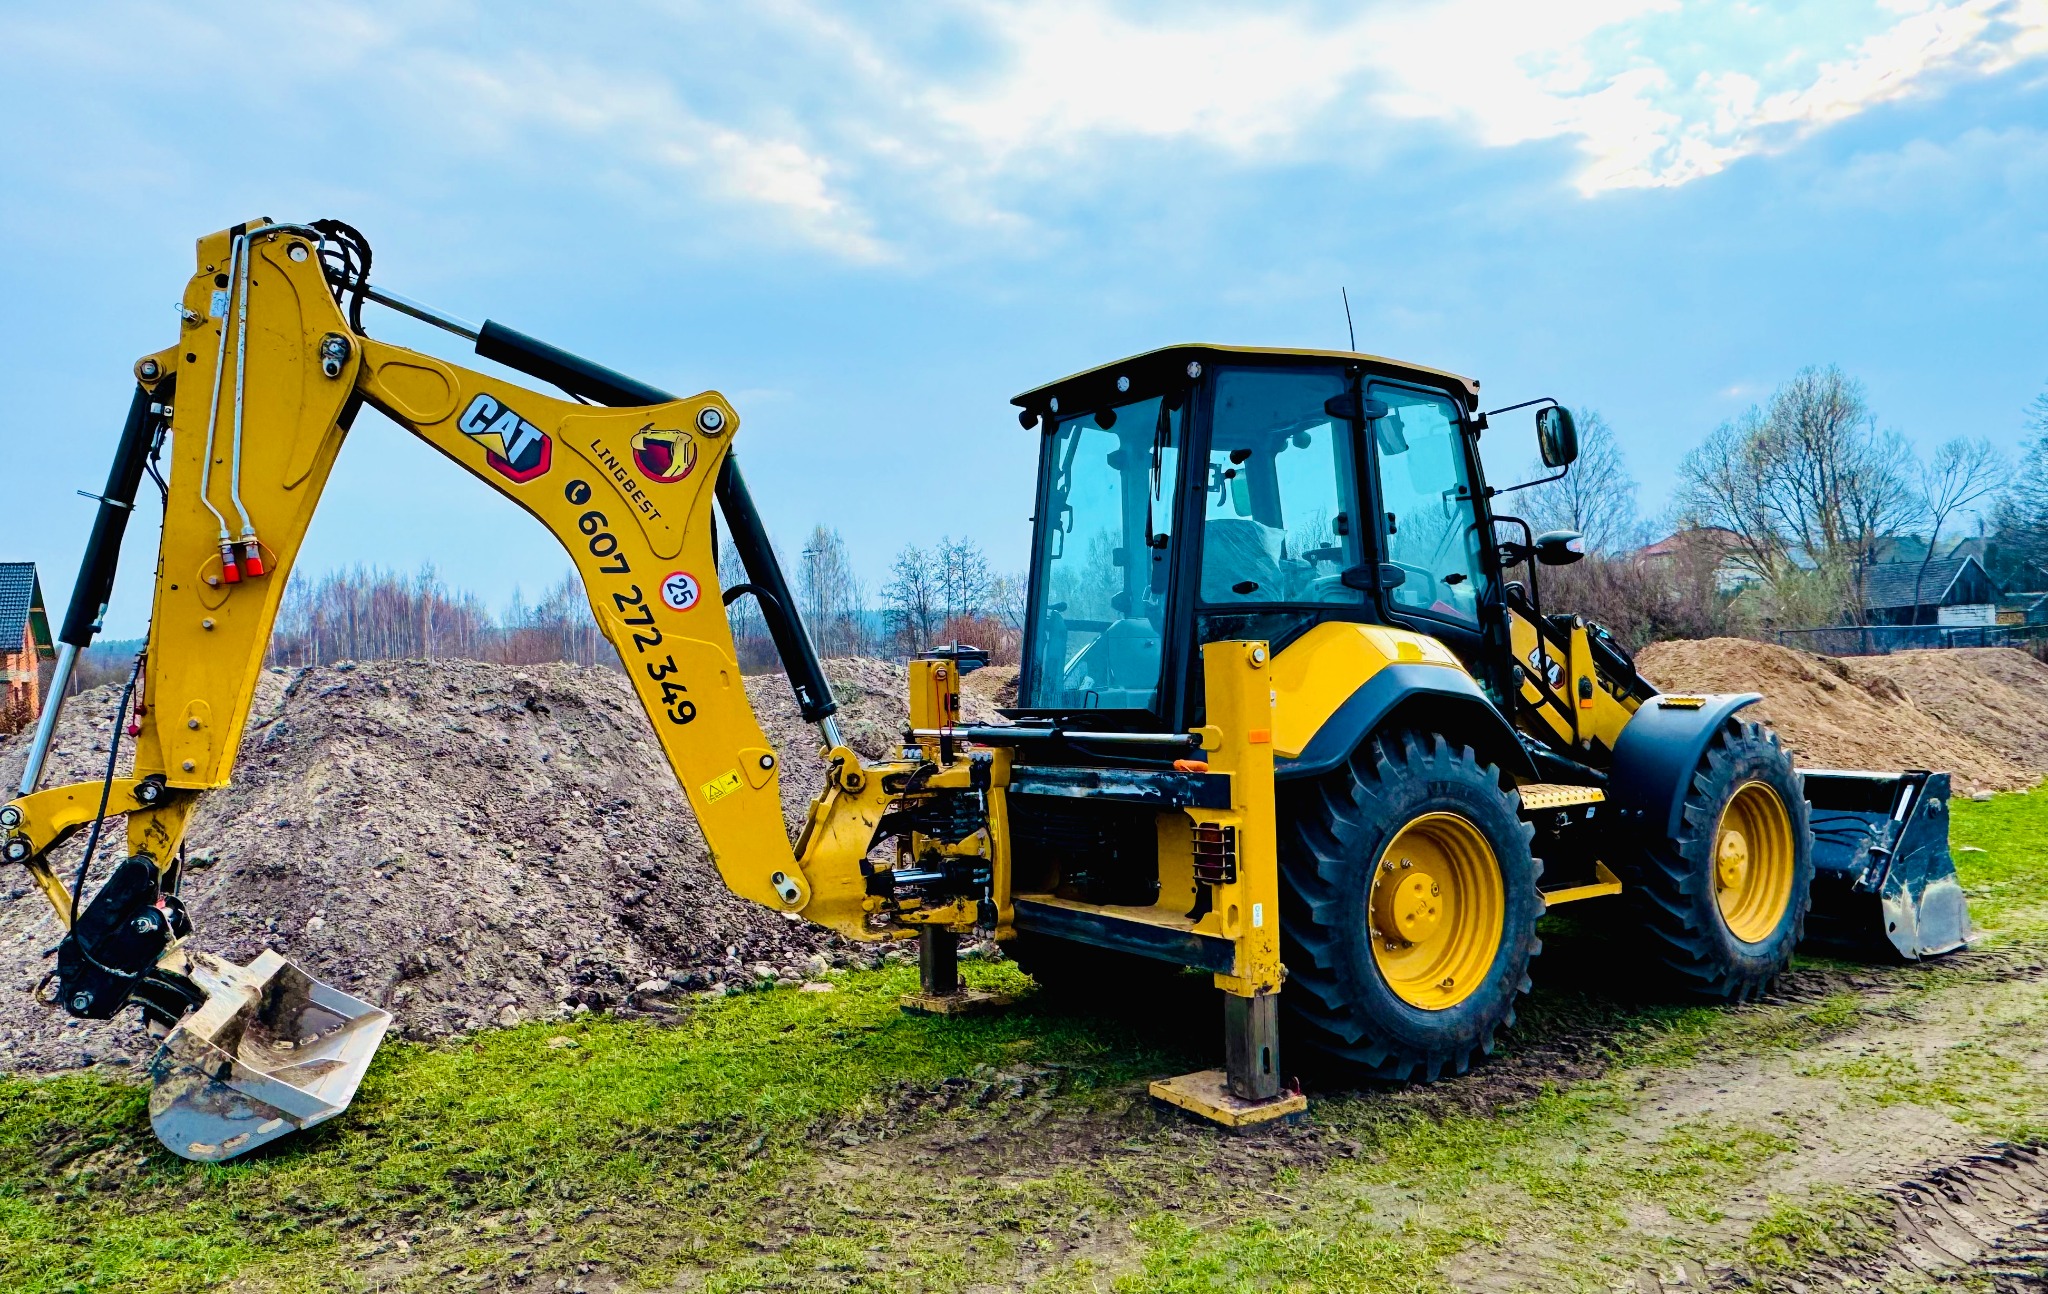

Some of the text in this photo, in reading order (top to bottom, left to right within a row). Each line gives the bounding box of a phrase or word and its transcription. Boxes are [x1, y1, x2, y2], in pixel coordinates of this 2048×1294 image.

[459, 394, 544, 464] CAT
[590, 438, 662, 521] LINGBEST
[578, 510, 697, 725] 607 272 349
[666, 577, 694, 606] 25
[1529, 648, 1560, 685] 44
